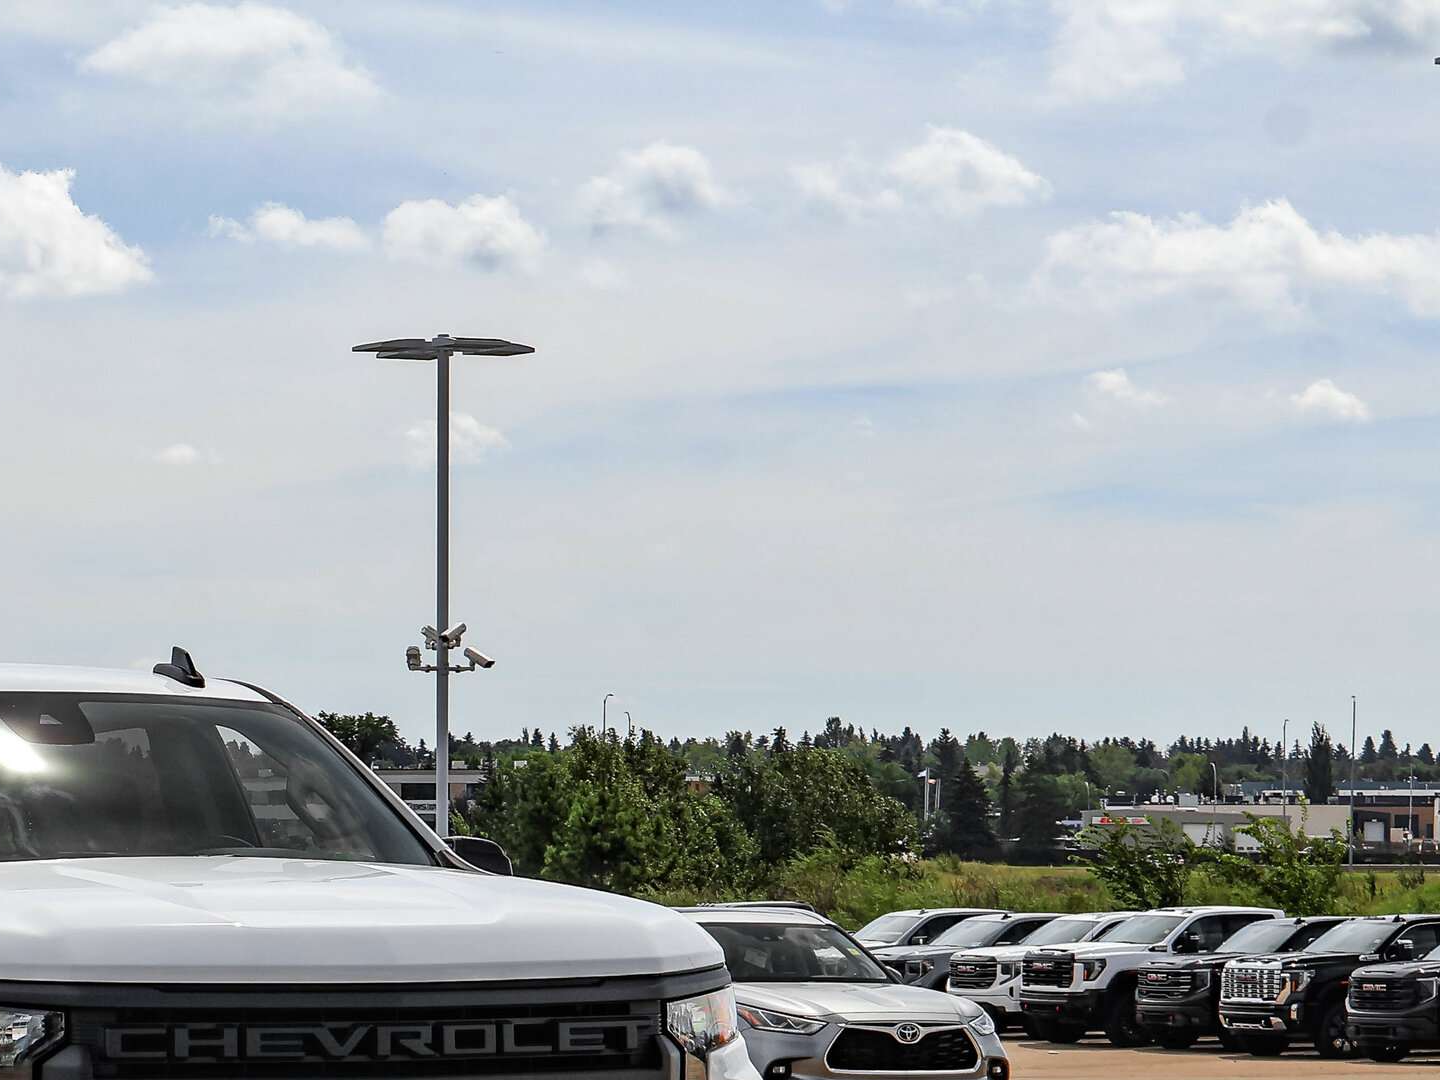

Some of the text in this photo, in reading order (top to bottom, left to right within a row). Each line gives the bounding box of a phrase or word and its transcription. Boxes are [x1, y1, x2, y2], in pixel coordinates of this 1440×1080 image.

[957, 965, 976, 973] GMC
[1362, 984, 1387, 992] GMC
[105, 1017, 651, 1060] CHEVROLET
